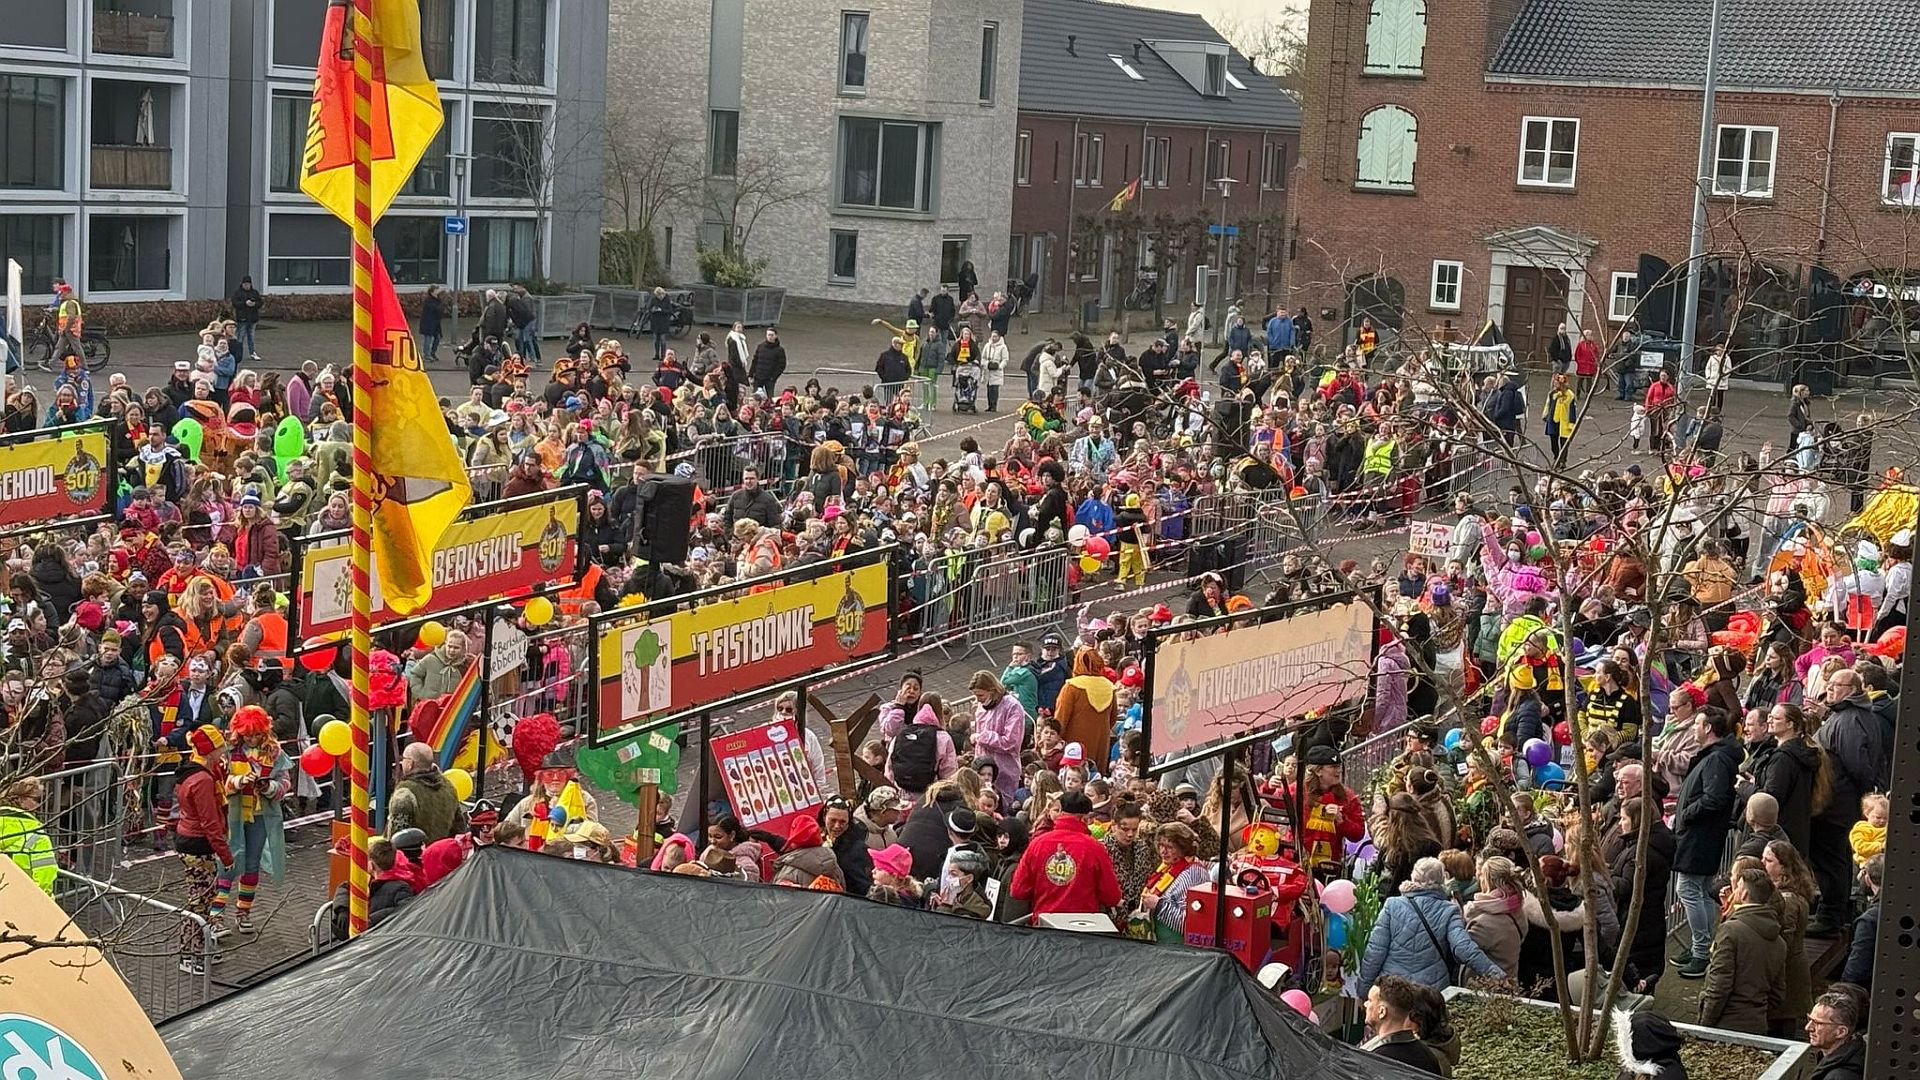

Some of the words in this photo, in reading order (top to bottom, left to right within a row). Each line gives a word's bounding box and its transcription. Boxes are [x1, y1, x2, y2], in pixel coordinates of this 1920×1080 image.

[0, 464, 57, 502] CHOOL
[66, 470, 99, 491] SOT
[432, 531, 524, 588] BERKSKUS
[540, 536, 565, 559] SOT
[836, 609, 863, 635] SOT
